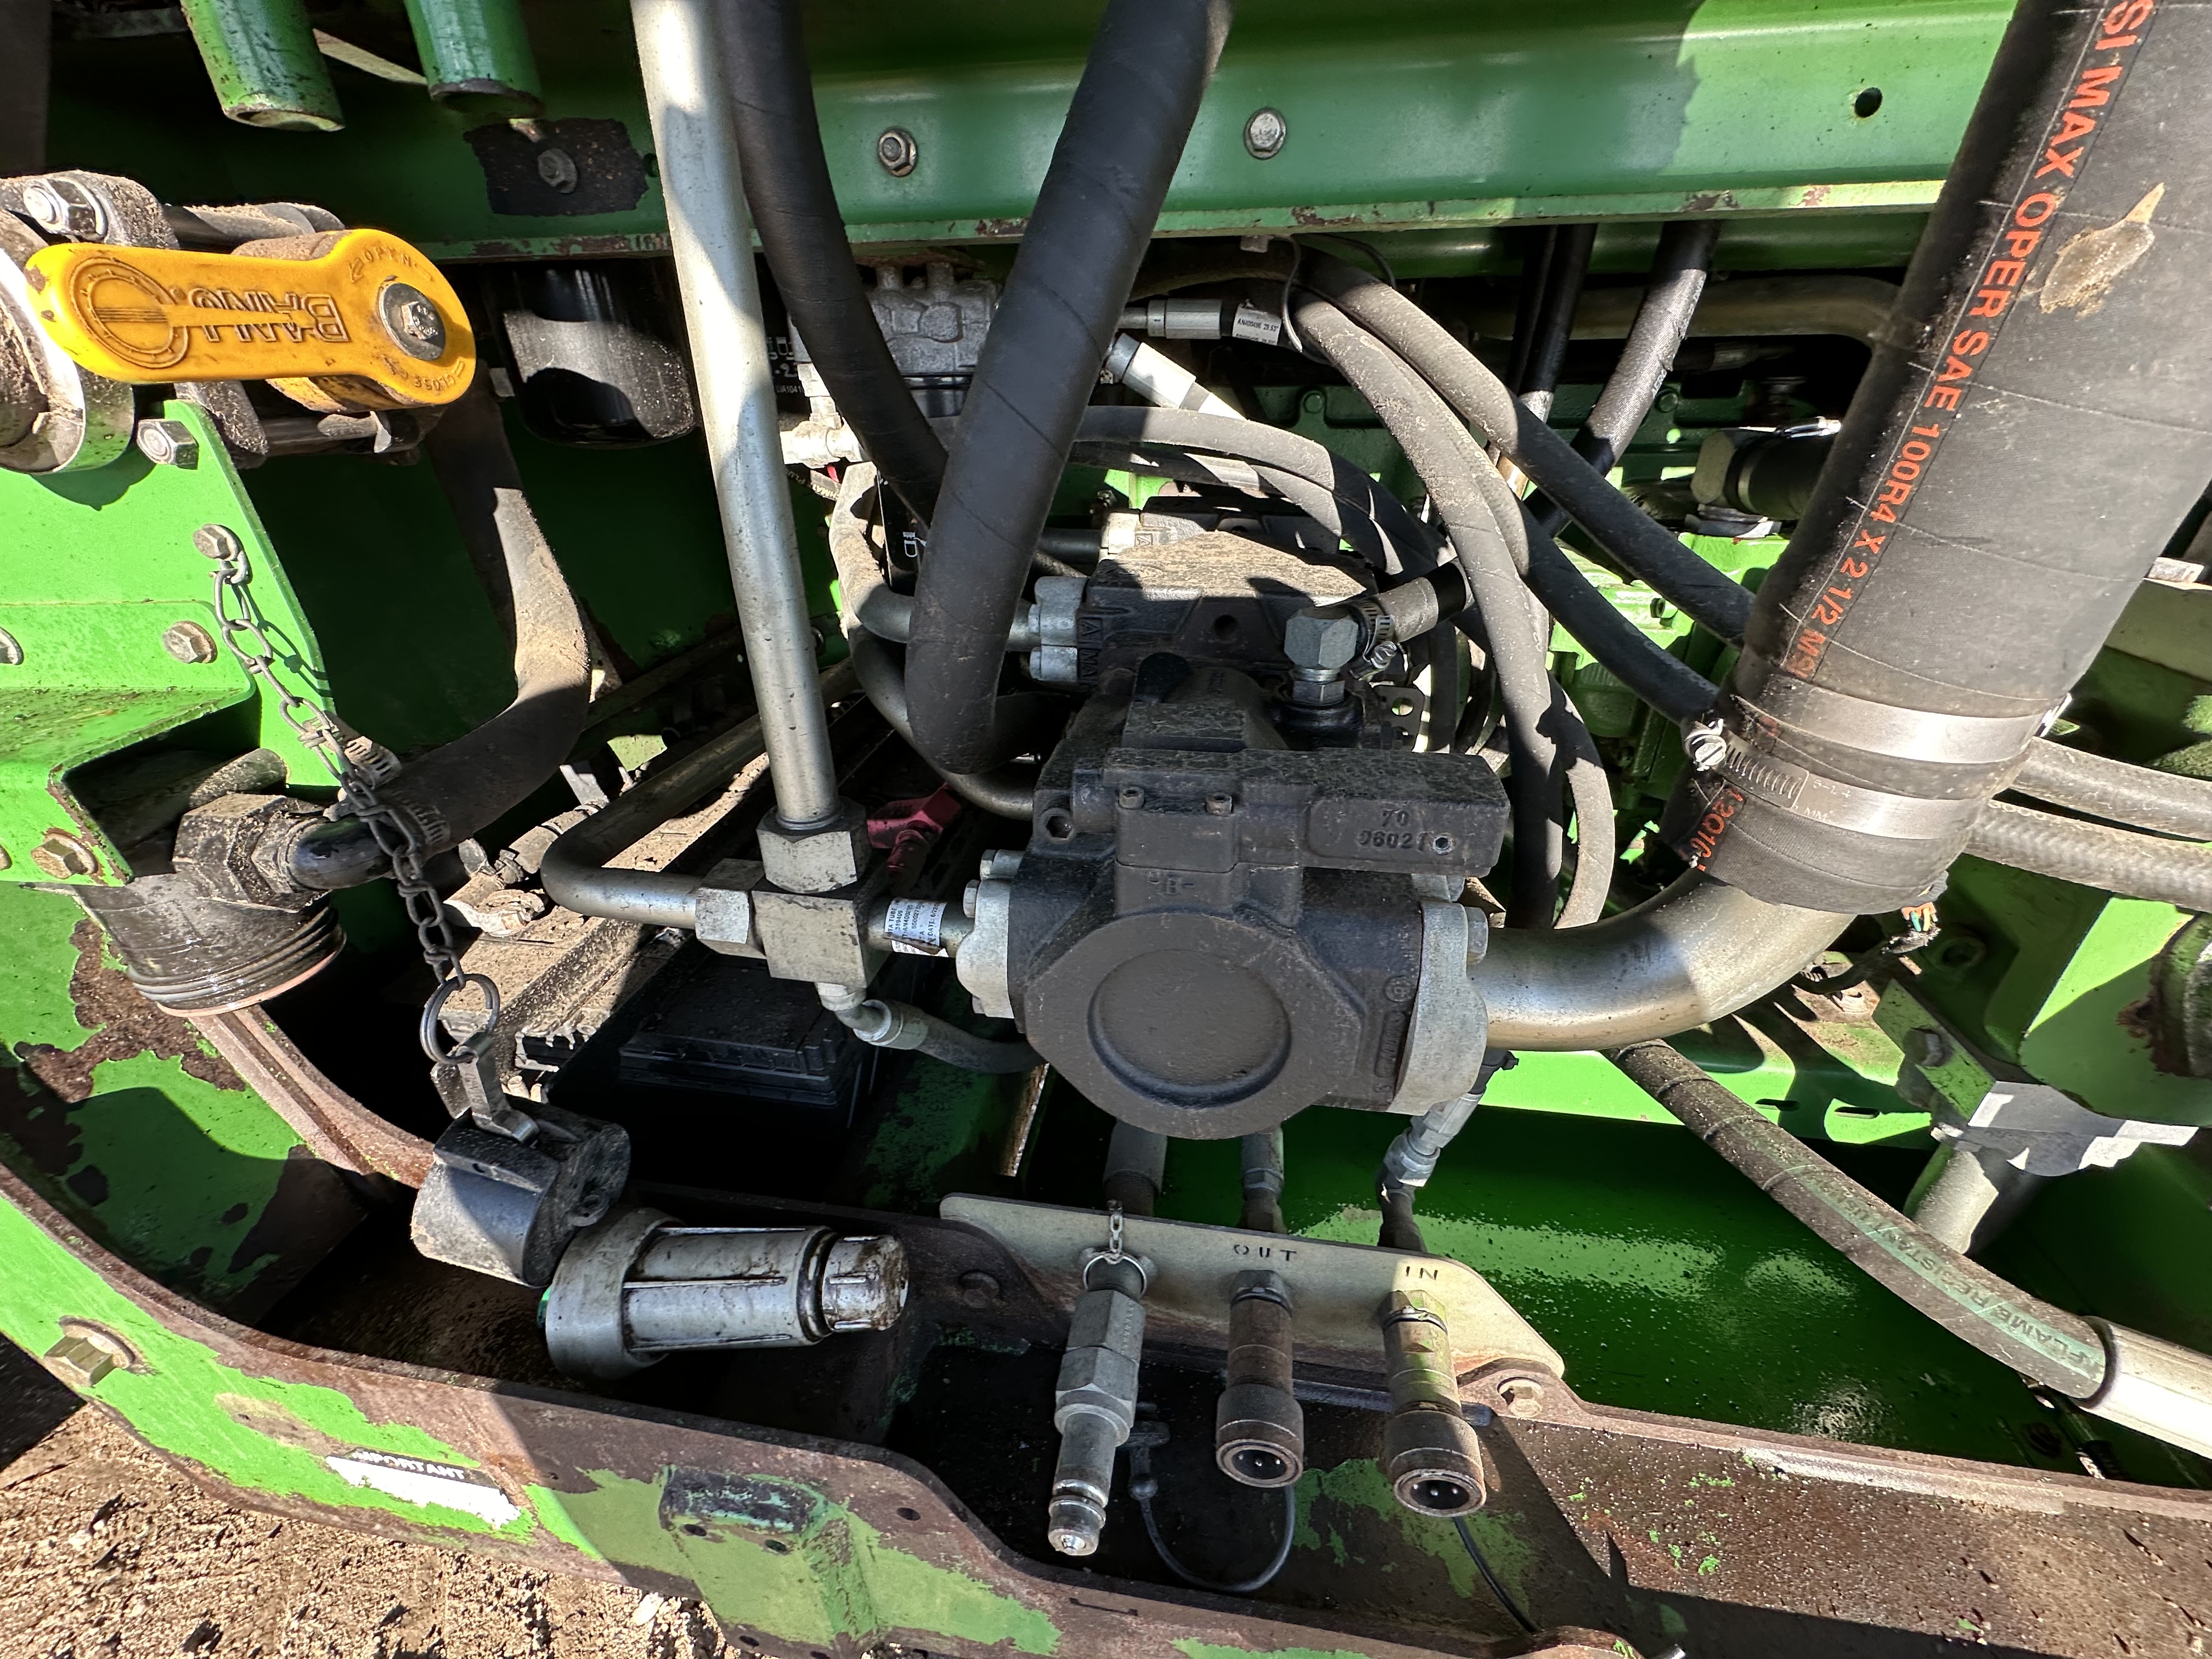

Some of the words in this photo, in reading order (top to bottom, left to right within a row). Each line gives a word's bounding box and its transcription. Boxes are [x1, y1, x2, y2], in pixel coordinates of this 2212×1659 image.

[2034, 66, 2122, 178] MAX
[1969, 192, 2055, 318] OPER
[1924, 328, 1989, 411] SAE
[1869, 423, 1940, 523] 100R4
[1853, 529, 1886, 554] X
[1839, 556, 1869, 578] 2
[1812, 586, 1852, 626] 1/2
[889, 907, 897, 922] TUBE
[1233, 1244, 1297, 1261] OUT
[1406, 1266, 1438, 1280] IN
[1996, 1303, 2087, 1362] FLAME
